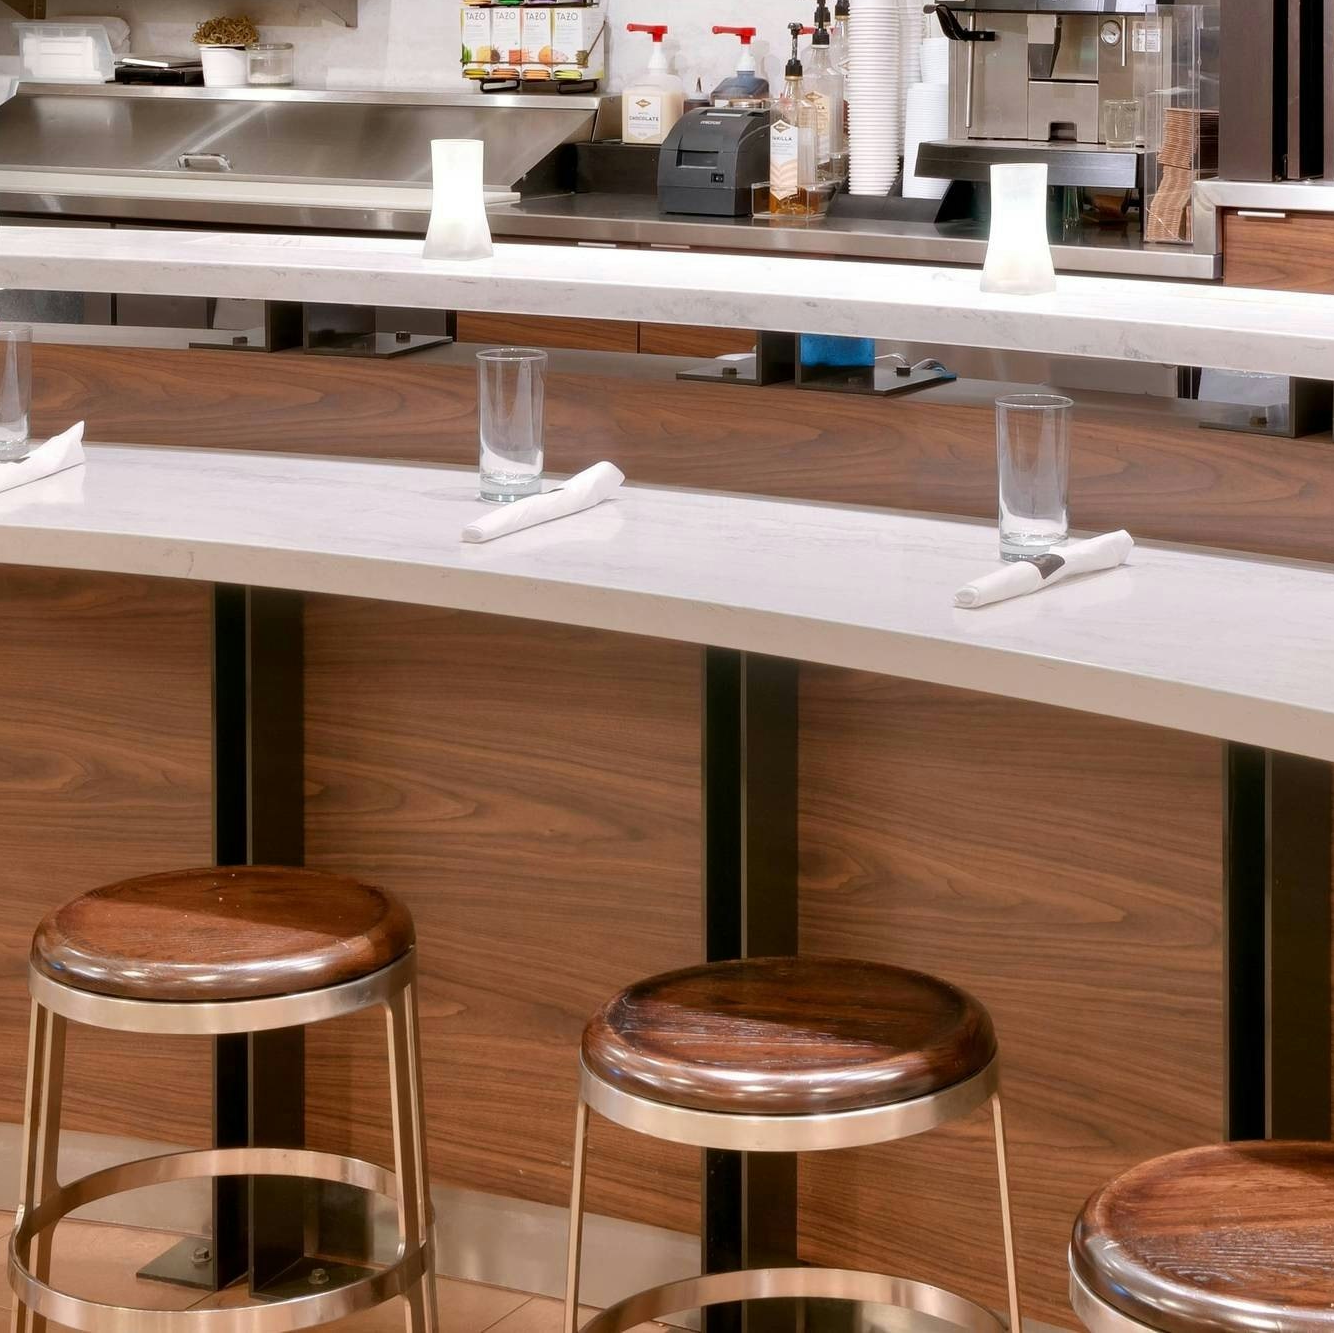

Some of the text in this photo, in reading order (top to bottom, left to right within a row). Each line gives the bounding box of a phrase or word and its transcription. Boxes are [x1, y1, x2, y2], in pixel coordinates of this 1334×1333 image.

[466, 12, 486, 20] TAZO
[495, 11, 516, 20] TAZO
[525, 12, 547, 20] TAZO
[557, 12, 578, 20] TAZO
